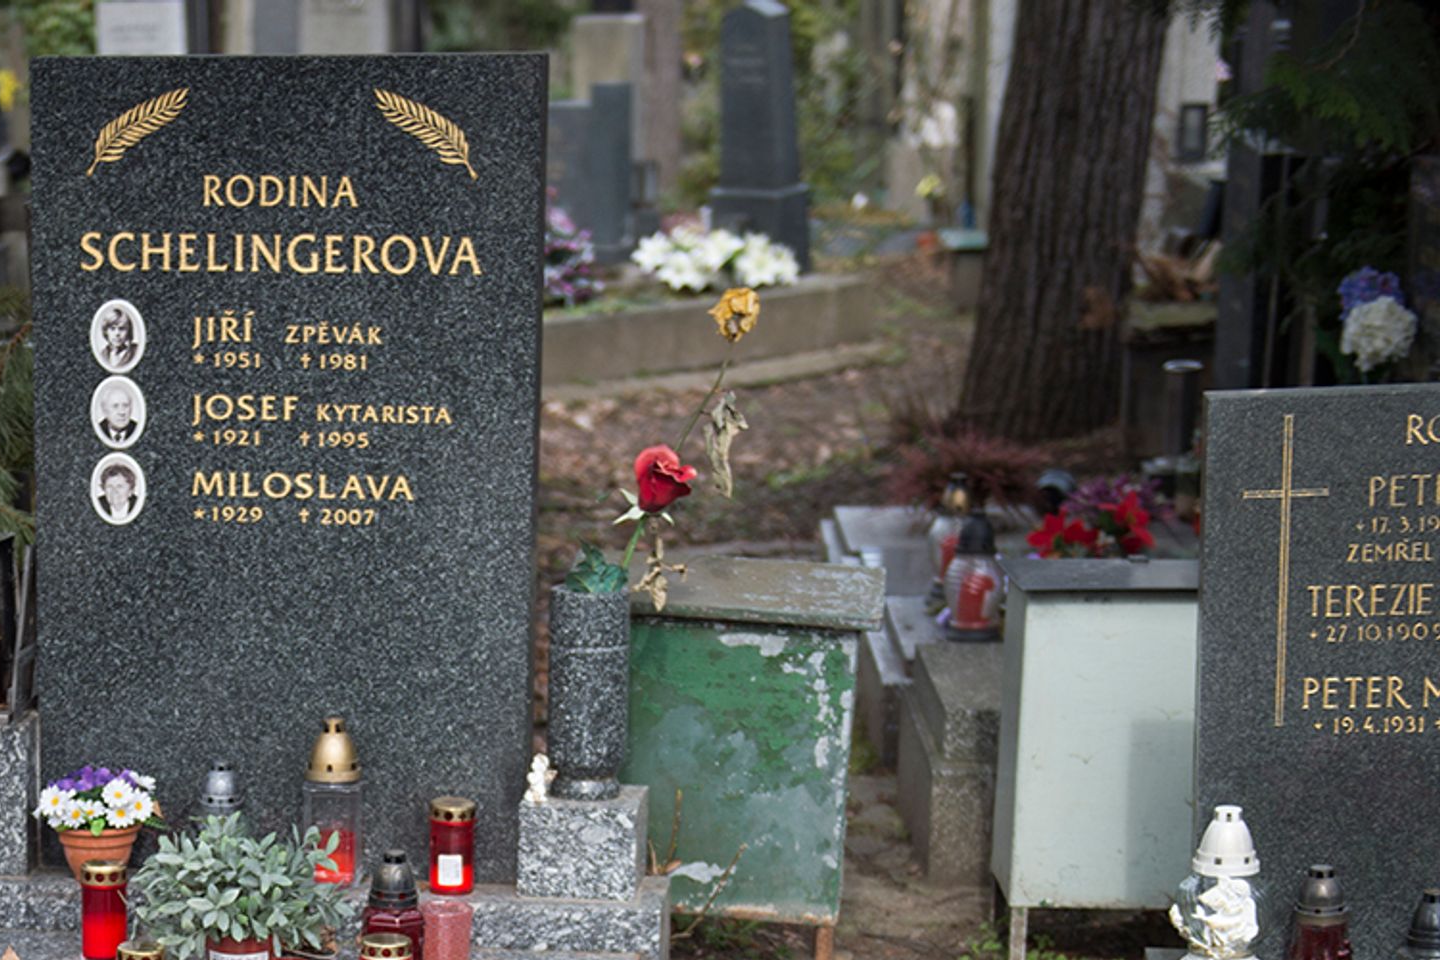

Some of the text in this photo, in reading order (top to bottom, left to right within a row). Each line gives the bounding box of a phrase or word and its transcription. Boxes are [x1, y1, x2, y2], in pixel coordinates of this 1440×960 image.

[202, 174, 359, 208] RODINA
[80, 231, 482, 275] SCHELINGEROVA
[192, 310, 383, 349] JIŘÍ ZPĚVÁK
[192, 394, 453, 426] JOSEF KYTARISTA
[192, 471, 414, 500] MILOSLAVA
[1369, 474, 1440, 508] PET
[1346, 538, 1434, 563] ZEMŘEL
[1307, 583, 1434, 618] TEREZIE
[1302, 676, 1412, 709] PETER
